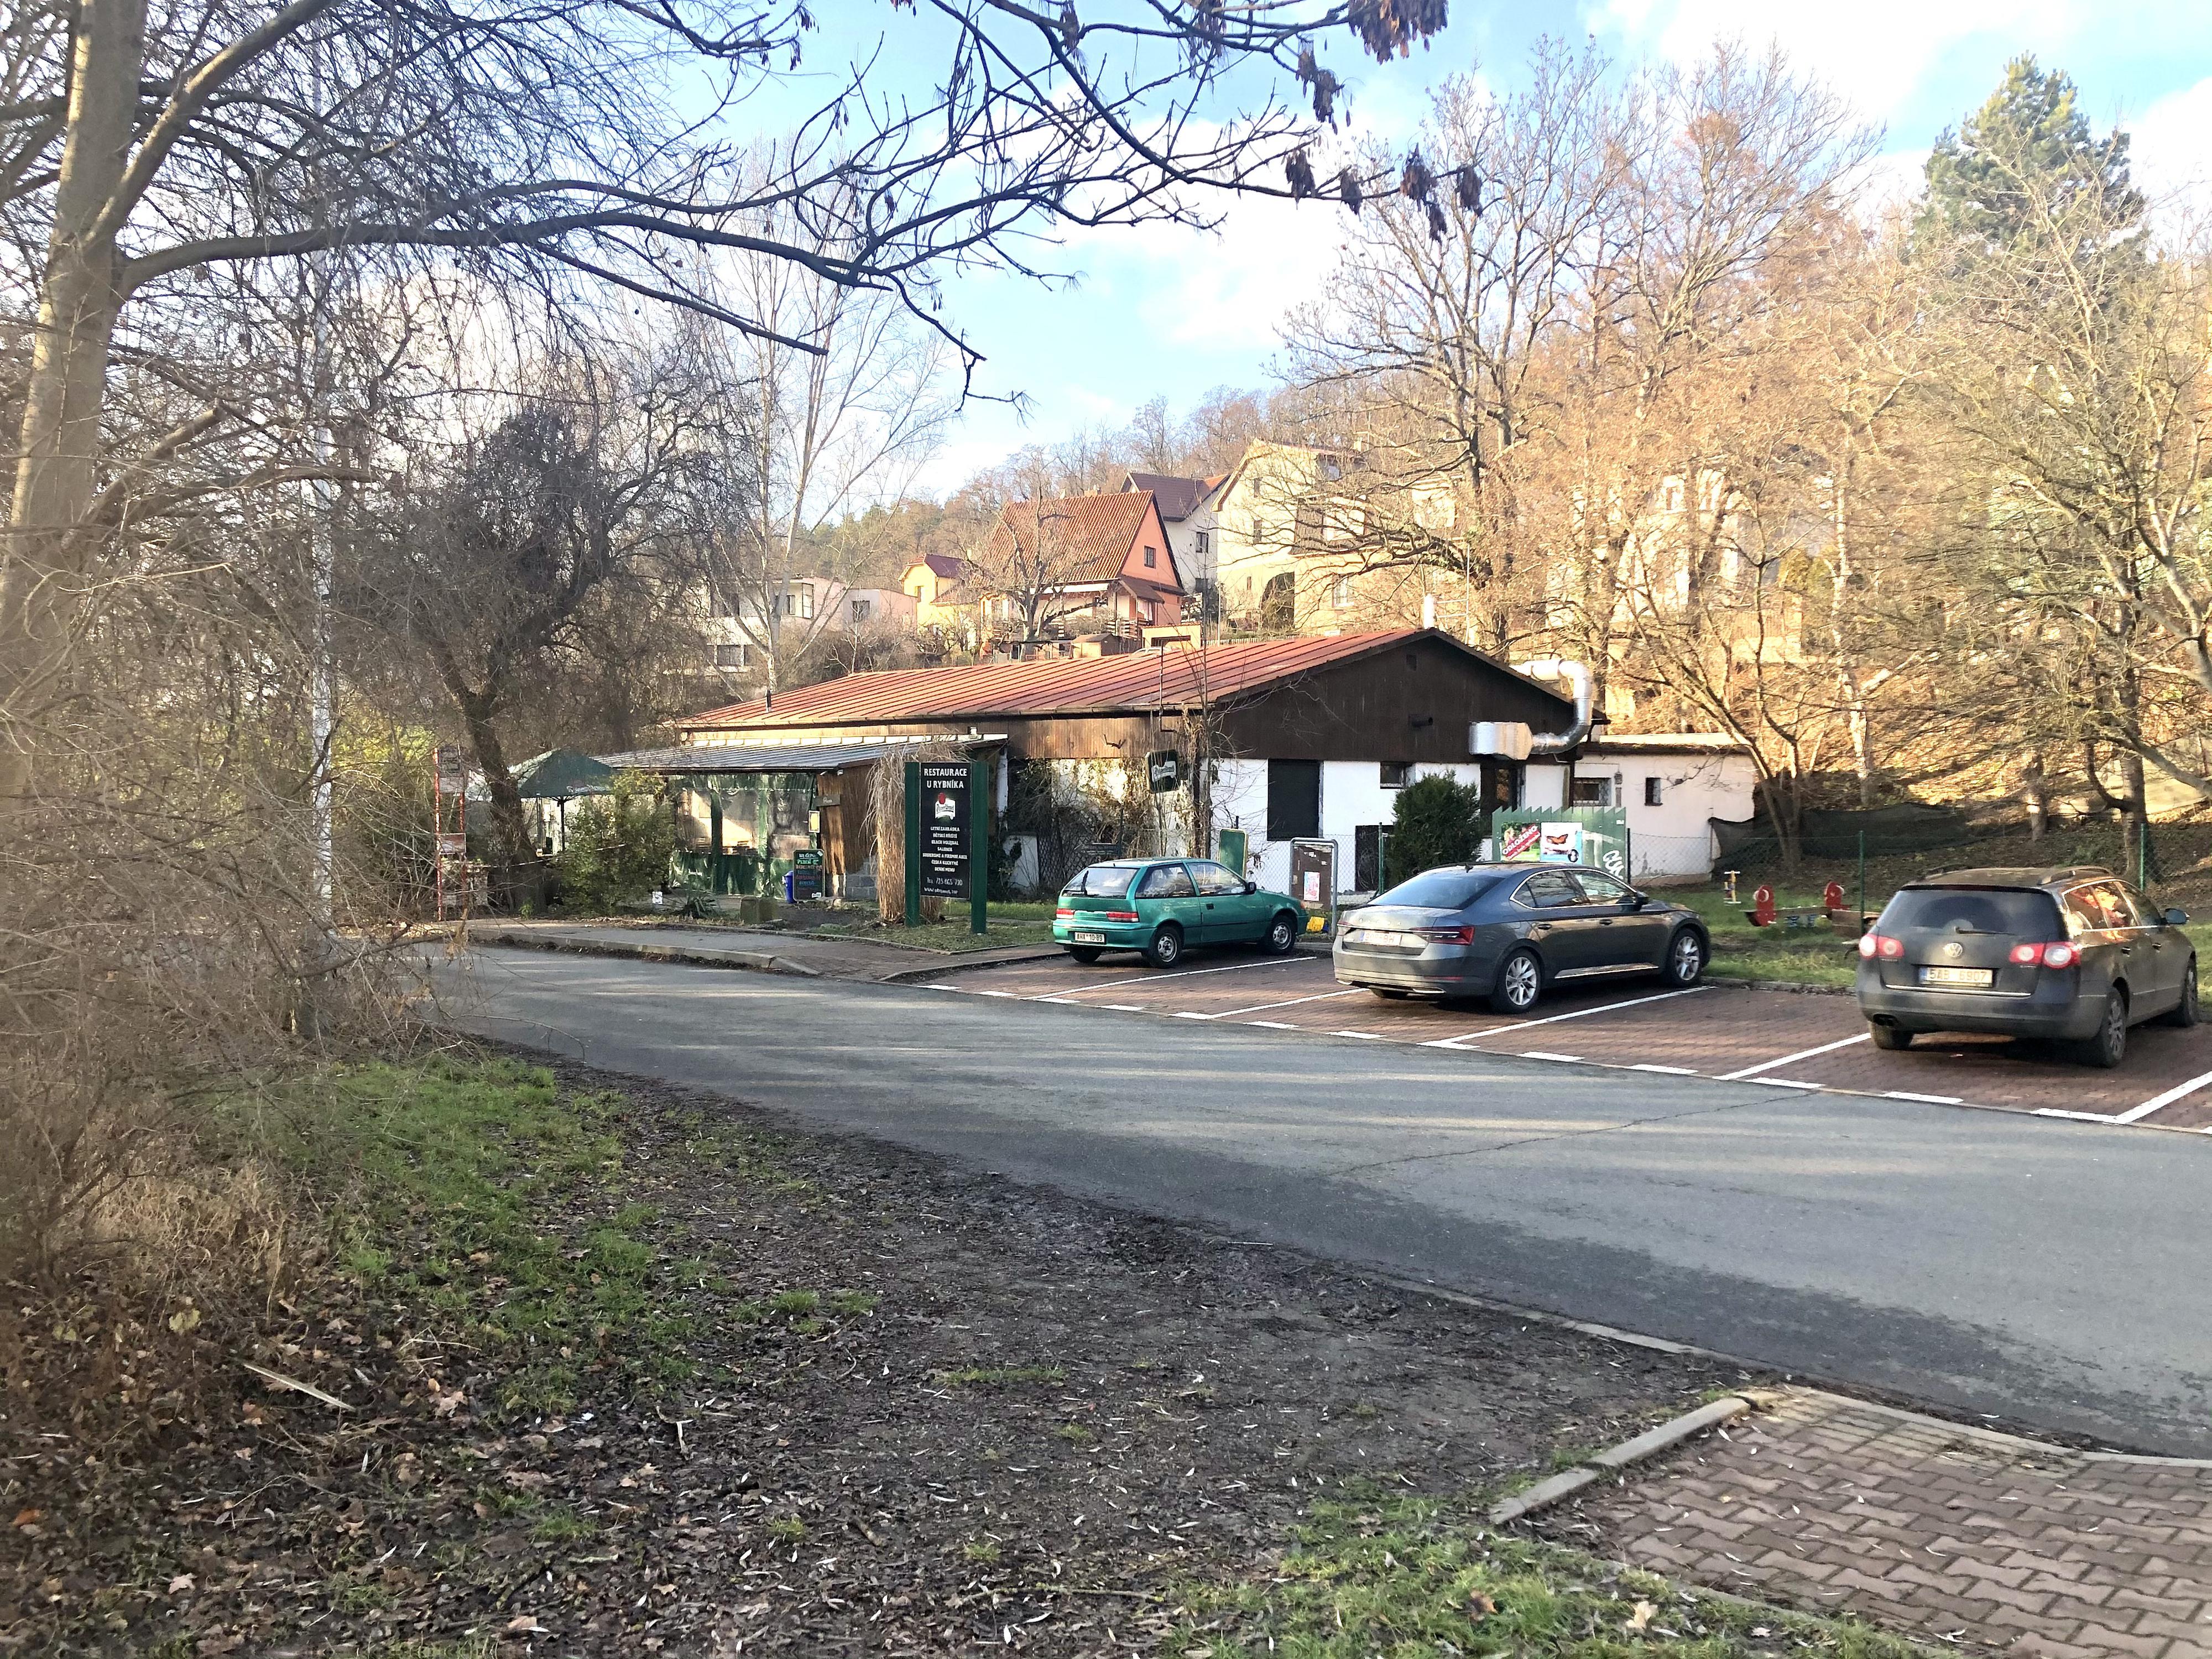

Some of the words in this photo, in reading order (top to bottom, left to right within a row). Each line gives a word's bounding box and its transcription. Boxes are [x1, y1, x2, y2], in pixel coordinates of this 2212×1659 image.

[924, 768, 967, 776] RESTAURACE
[927, 780, 931, 789] U
[933, 779, 964, 789] RYBNÍKA
